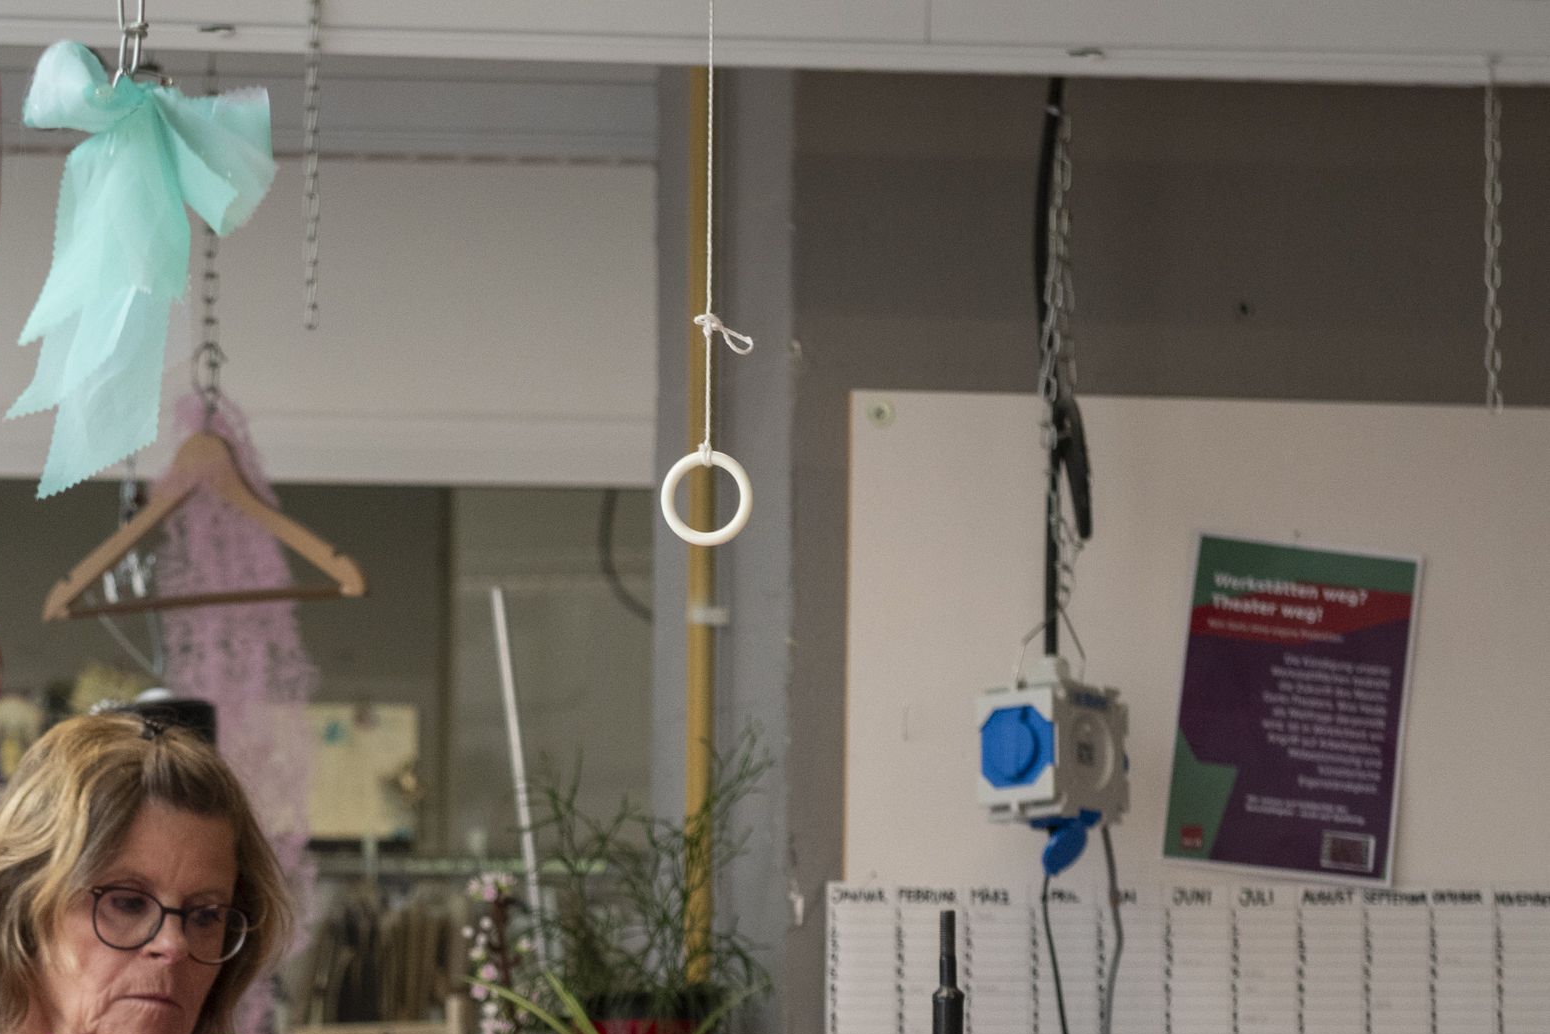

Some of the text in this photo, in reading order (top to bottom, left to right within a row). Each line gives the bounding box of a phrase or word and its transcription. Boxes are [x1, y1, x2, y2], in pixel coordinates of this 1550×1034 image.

[1323, 589, 1368, 608] weg?
[1212, 594, 1324, 624] Theater weg?
[1172, 888, 1212, 906] JUNI
[1238, 888, 1275, 907] JULI
